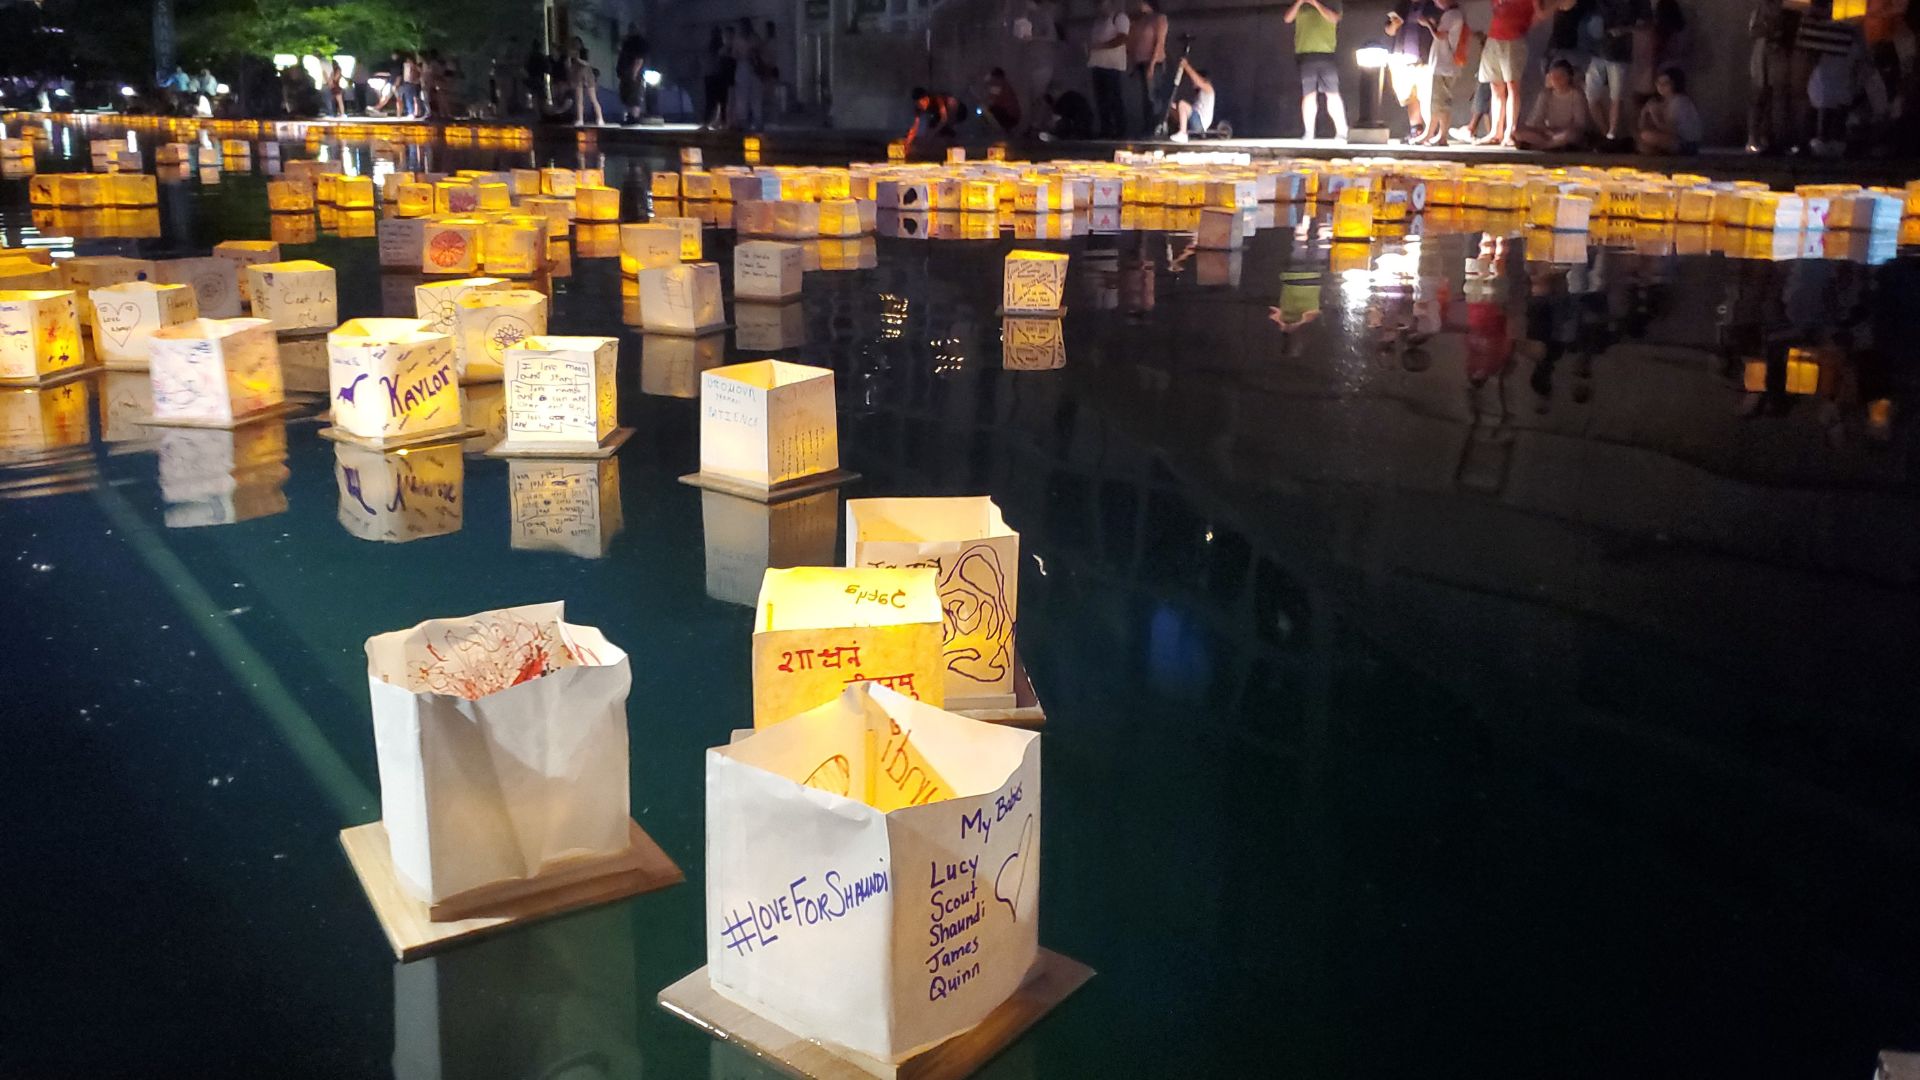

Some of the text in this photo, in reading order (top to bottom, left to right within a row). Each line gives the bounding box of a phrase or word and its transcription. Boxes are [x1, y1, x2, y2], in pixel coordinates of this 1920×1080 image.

[960, 807, 992, 844] My
[931, 854, 979, 889] Lucy
[931, 880, 978, 922] Scout
[929, 901, 985, 947] Shaundi
[925, 936, 979, 974] James
[929, 962, 980, 1002] Quinn
